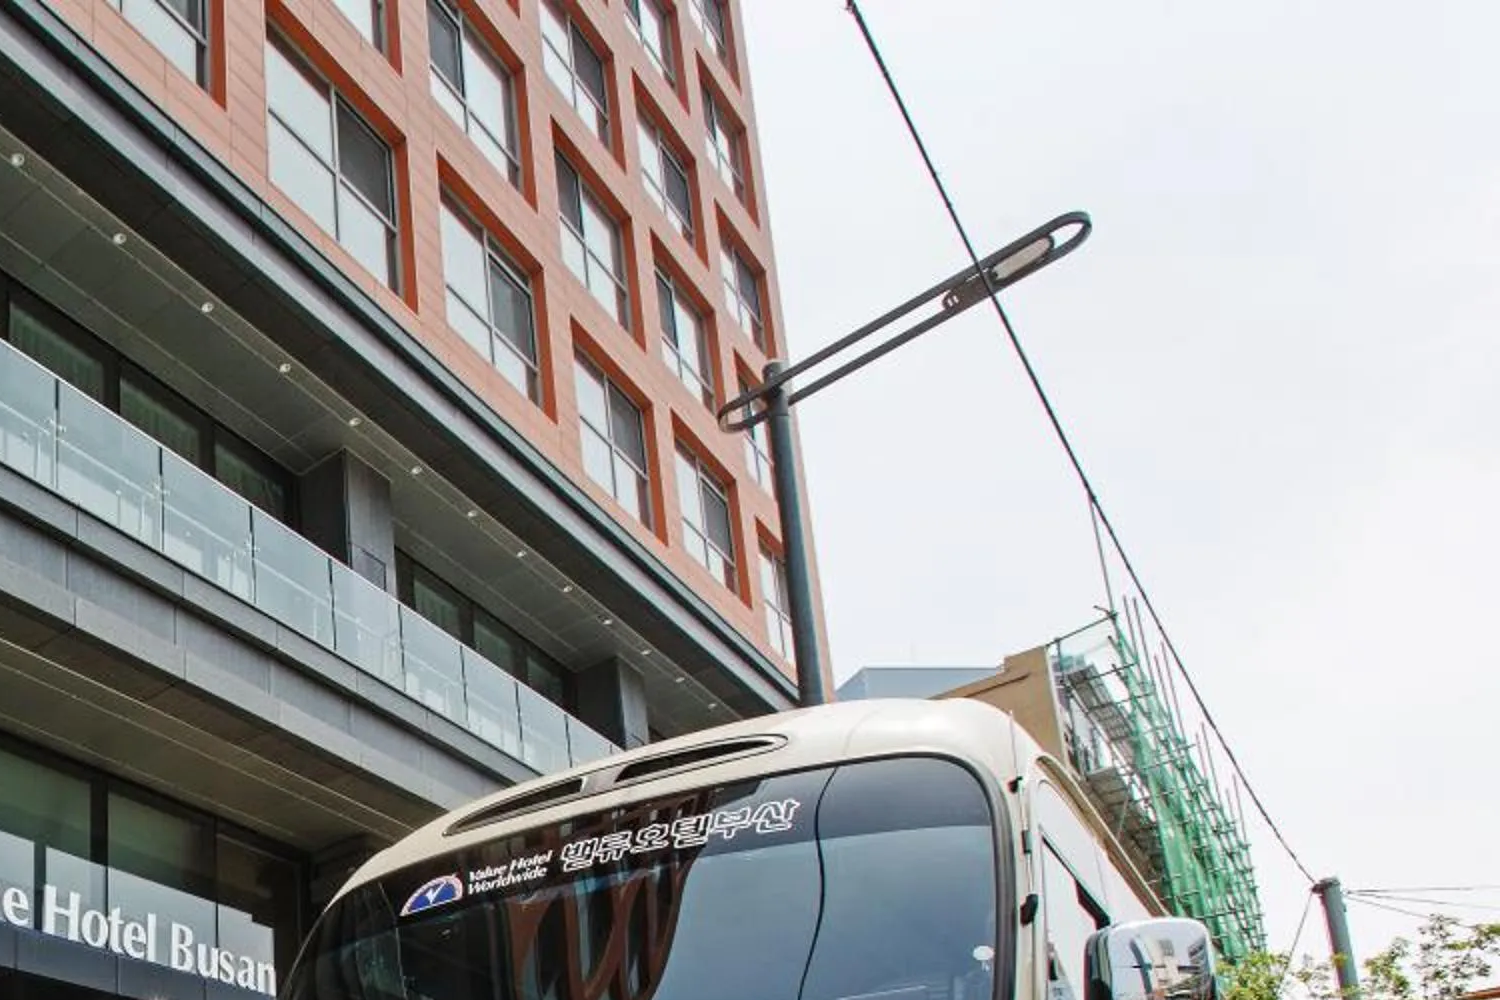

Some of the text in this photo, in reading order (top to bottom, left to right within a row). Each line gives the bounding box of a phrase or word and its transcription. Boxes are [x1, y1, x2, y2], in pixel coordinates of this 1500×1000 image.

[467, 866, 548, 896] Worldwide
[468, 849, 553, 883] Value Hotel
[42, 884, 157, 963] Hotel
[171, 921, 277, 997] Busan
